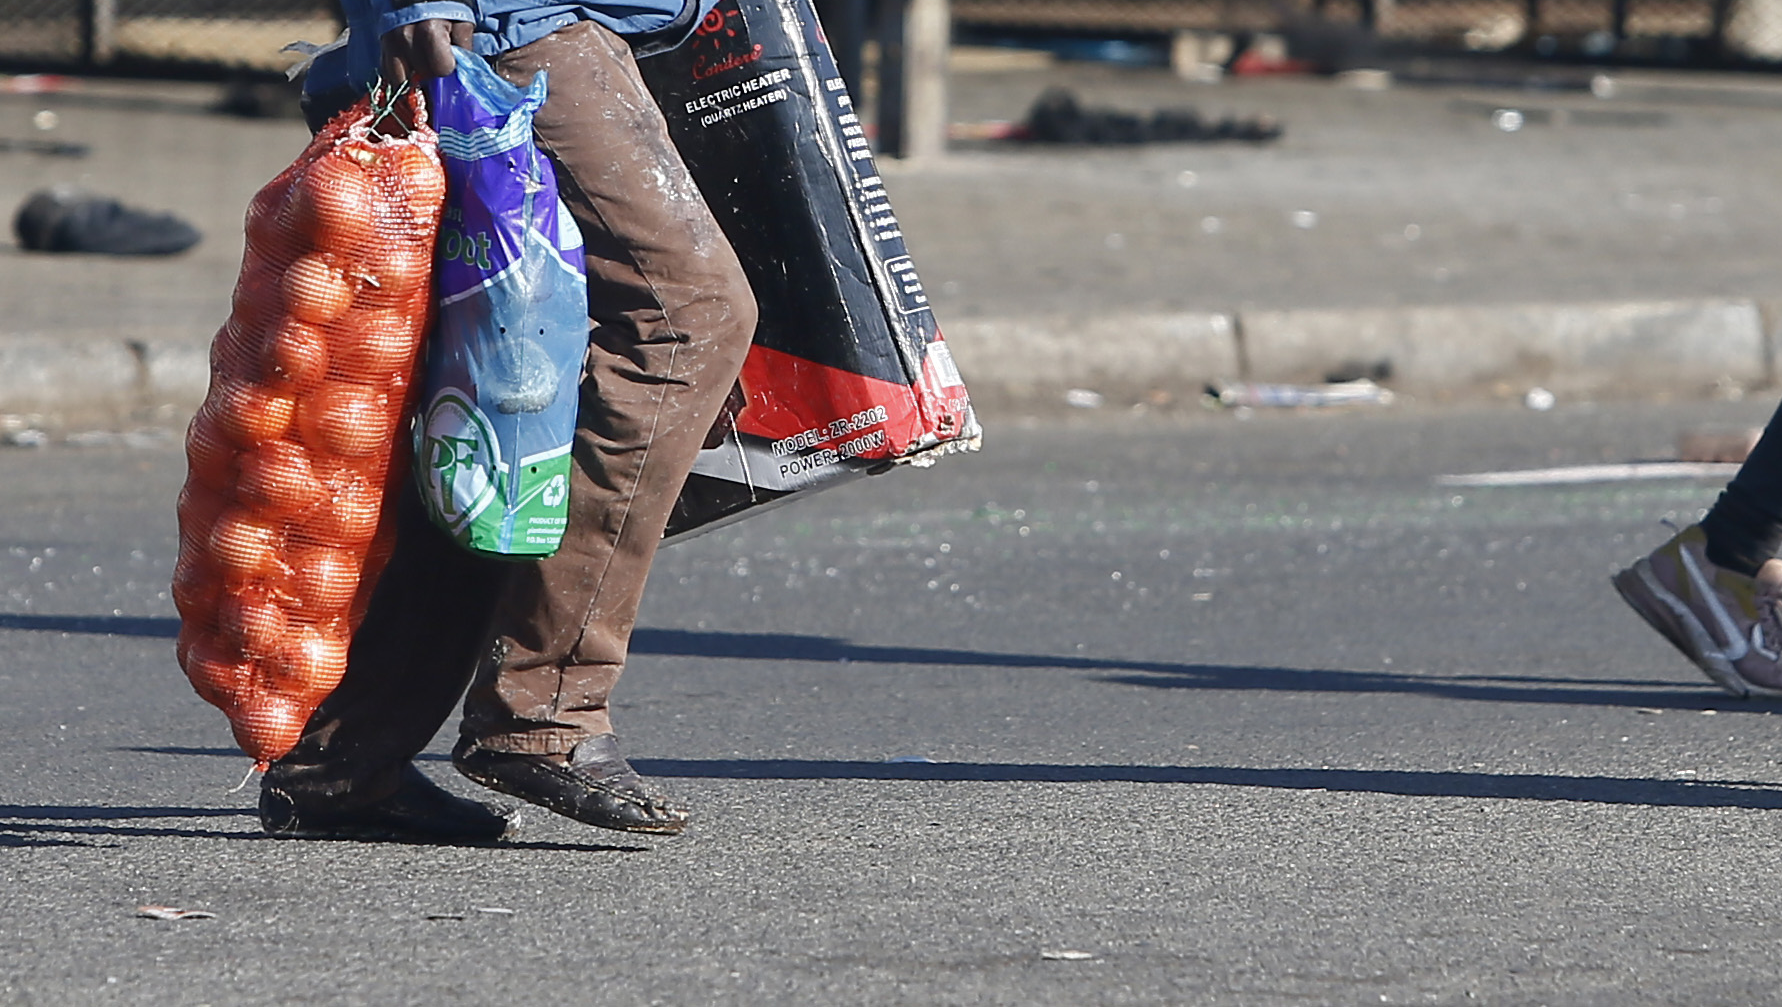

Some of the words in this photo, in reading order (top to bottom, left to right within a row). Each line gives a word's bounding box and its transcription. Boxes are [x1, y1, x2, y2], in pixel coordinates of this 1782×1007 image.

[685, 85, 741, 114] ELECTRIC
[741, 68, 792, 94] HEATER
[701, 104, 744, 128] (QUARTZ
[743, 88, 787, 111] HEATER)
[771, 428, 830, 458] MODEL:
[829, 405, 889, 439] ZR-2202
[779, 448, 840, 479] POWER:
[838, 429, 886, 460] 2000W
